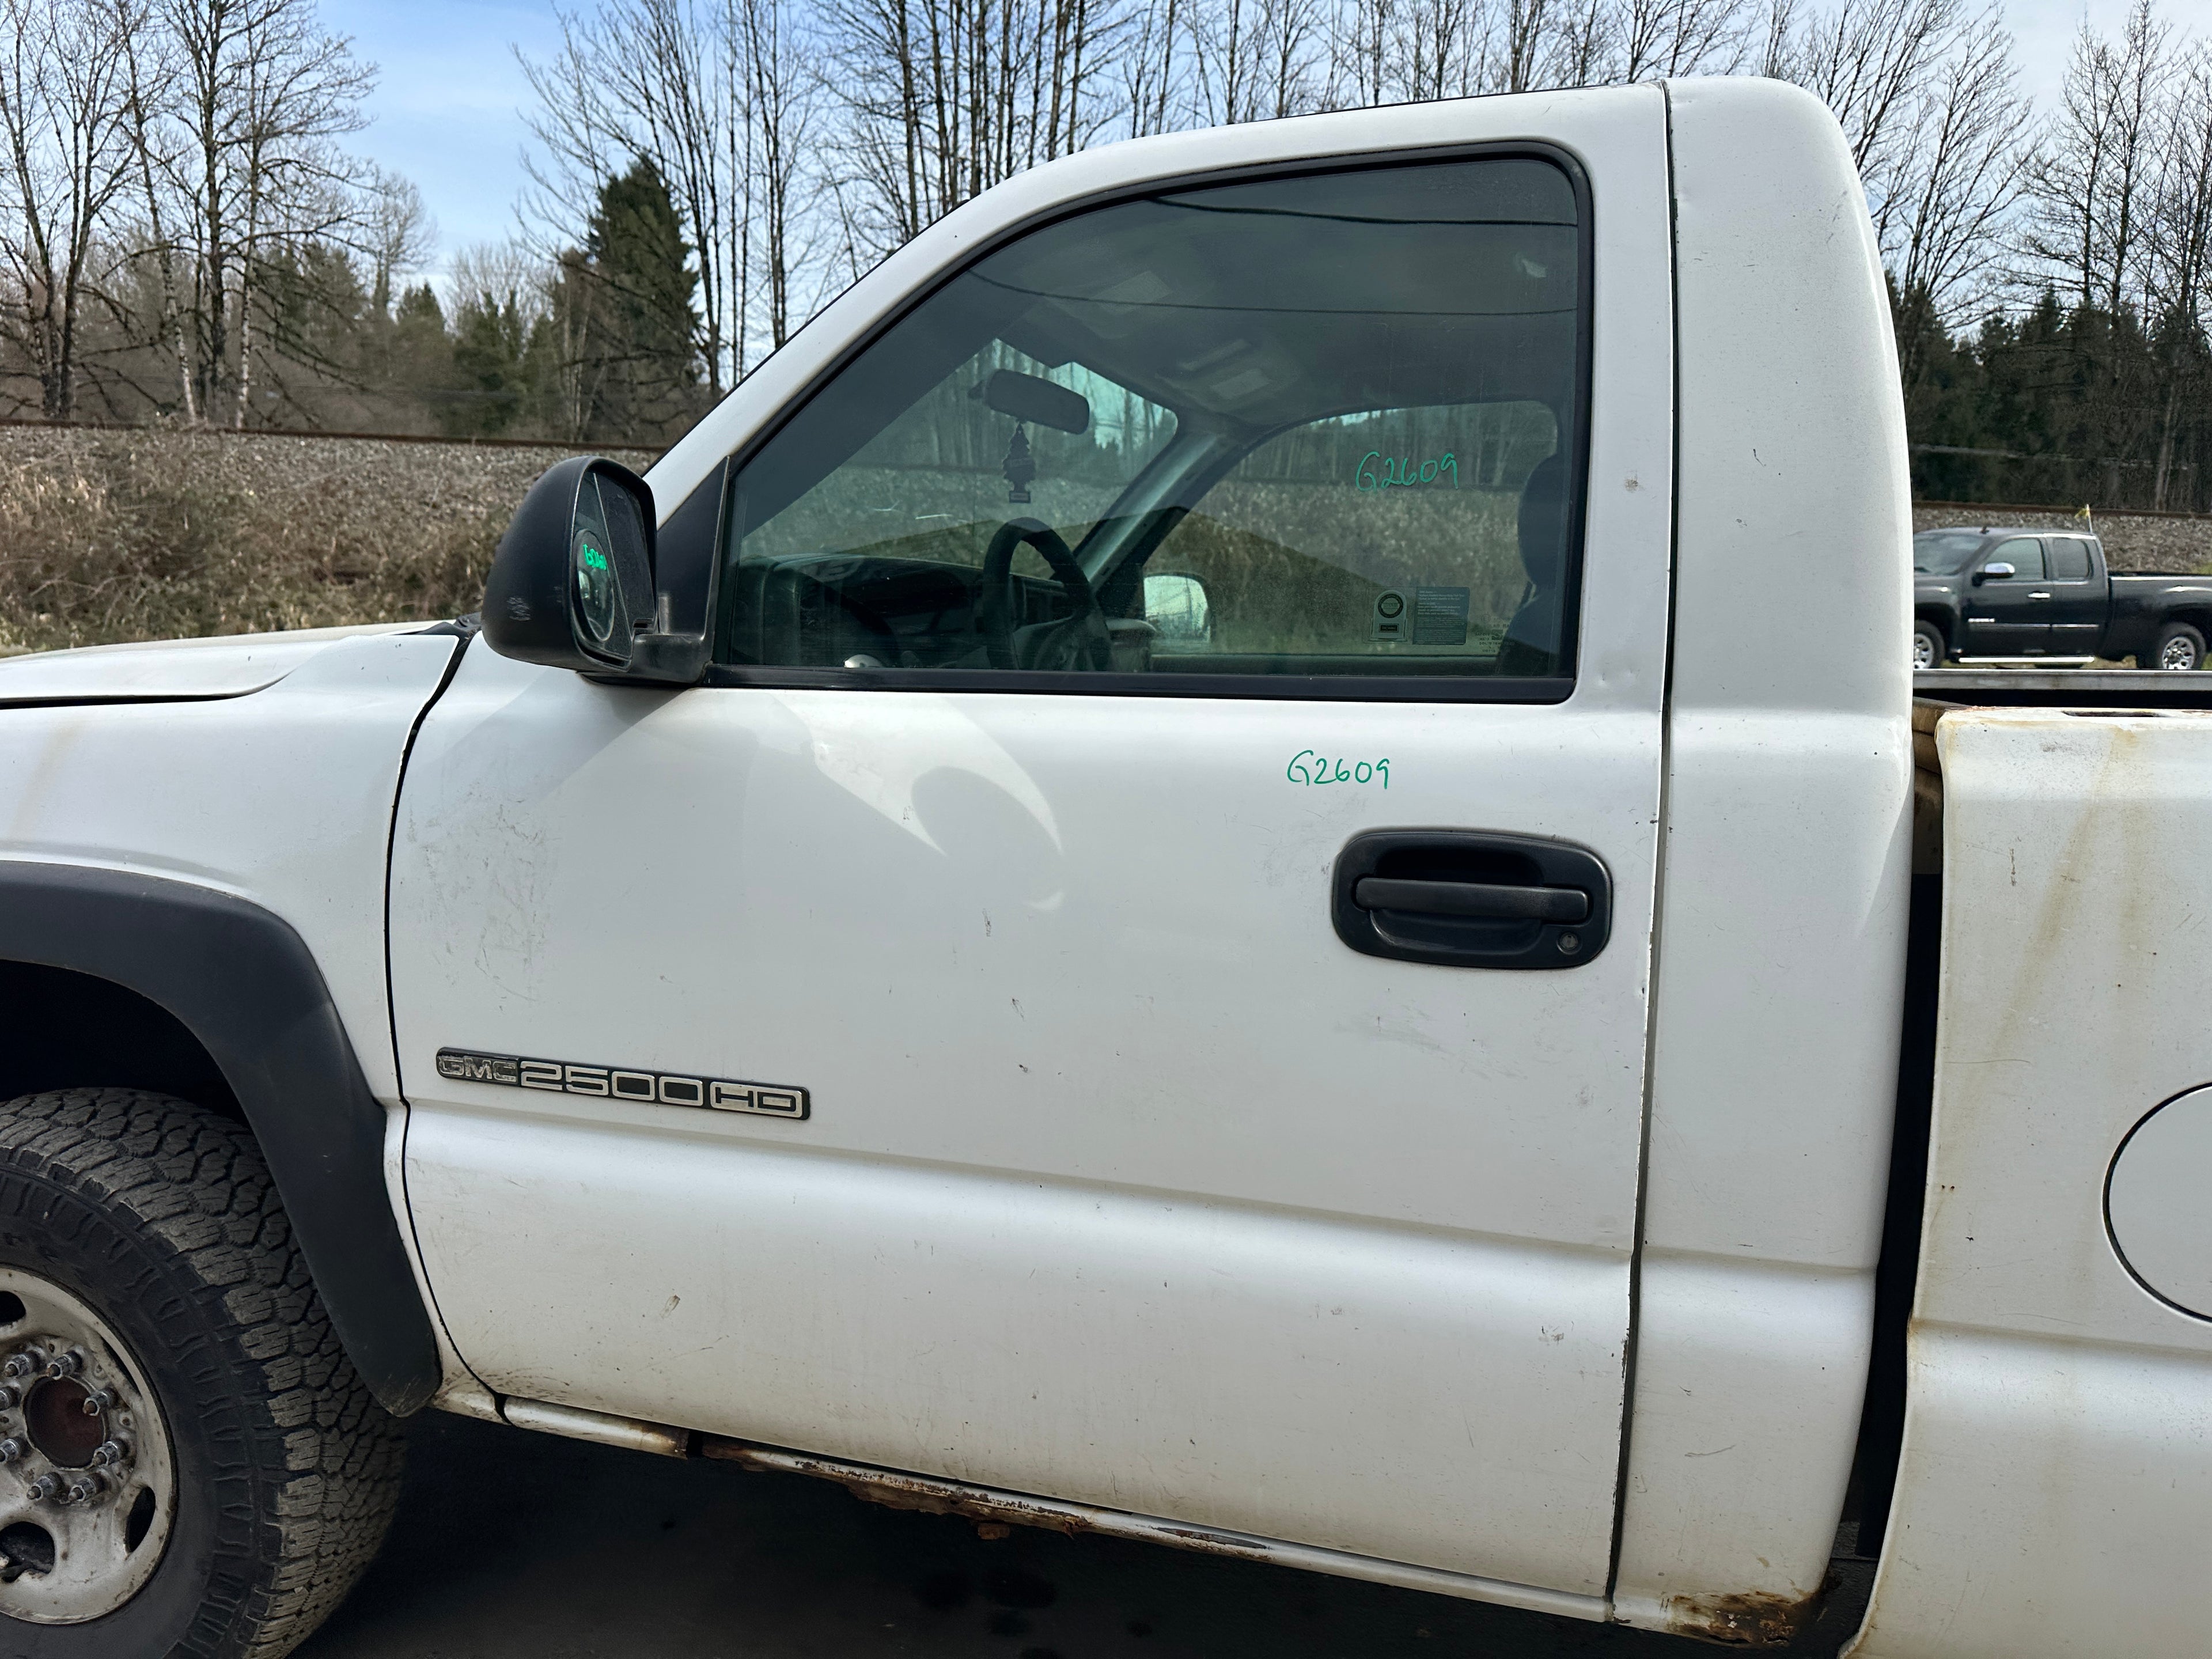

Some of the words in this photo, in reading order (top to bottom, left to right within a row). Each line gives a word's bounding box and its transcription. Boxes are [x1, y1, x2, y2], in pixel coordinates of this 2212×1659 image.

[1355, 451, 1459, 494] G2609
[1287, 749, 1390, 790] G2609
[438, 1055, 517, 1083] GMC
